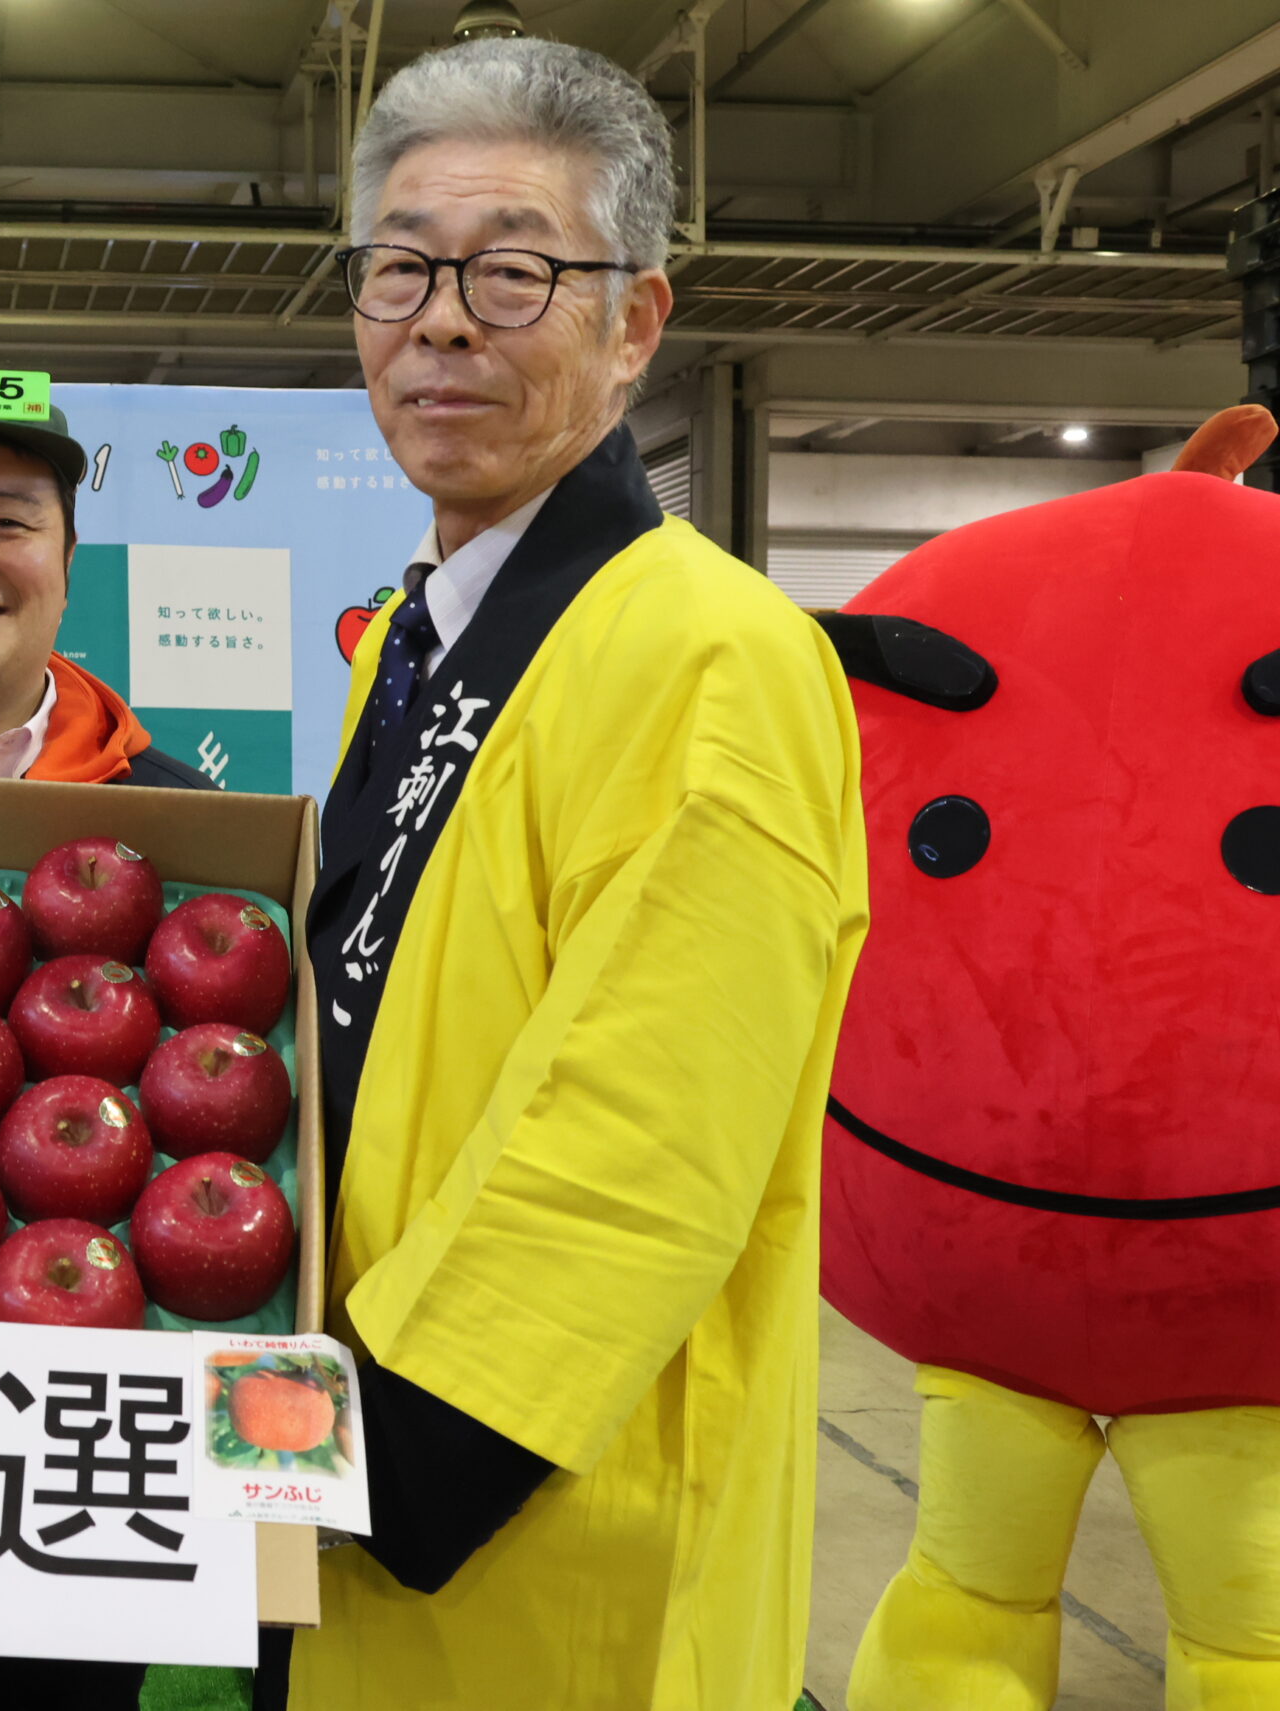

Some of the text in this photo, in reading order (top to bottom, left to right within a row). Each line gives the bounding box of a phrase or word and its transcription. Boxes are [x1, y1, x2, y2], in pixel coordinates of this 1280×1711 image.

[158, 606, 264, 622] 知って欲しい。
[158, 633, 264, 650] 感動する旨さ。
[63, 651, 87, 659] know
[332, 680, 491, 1027] 江刺りんご
[243, 1483, 323, 1503] サンふじ
